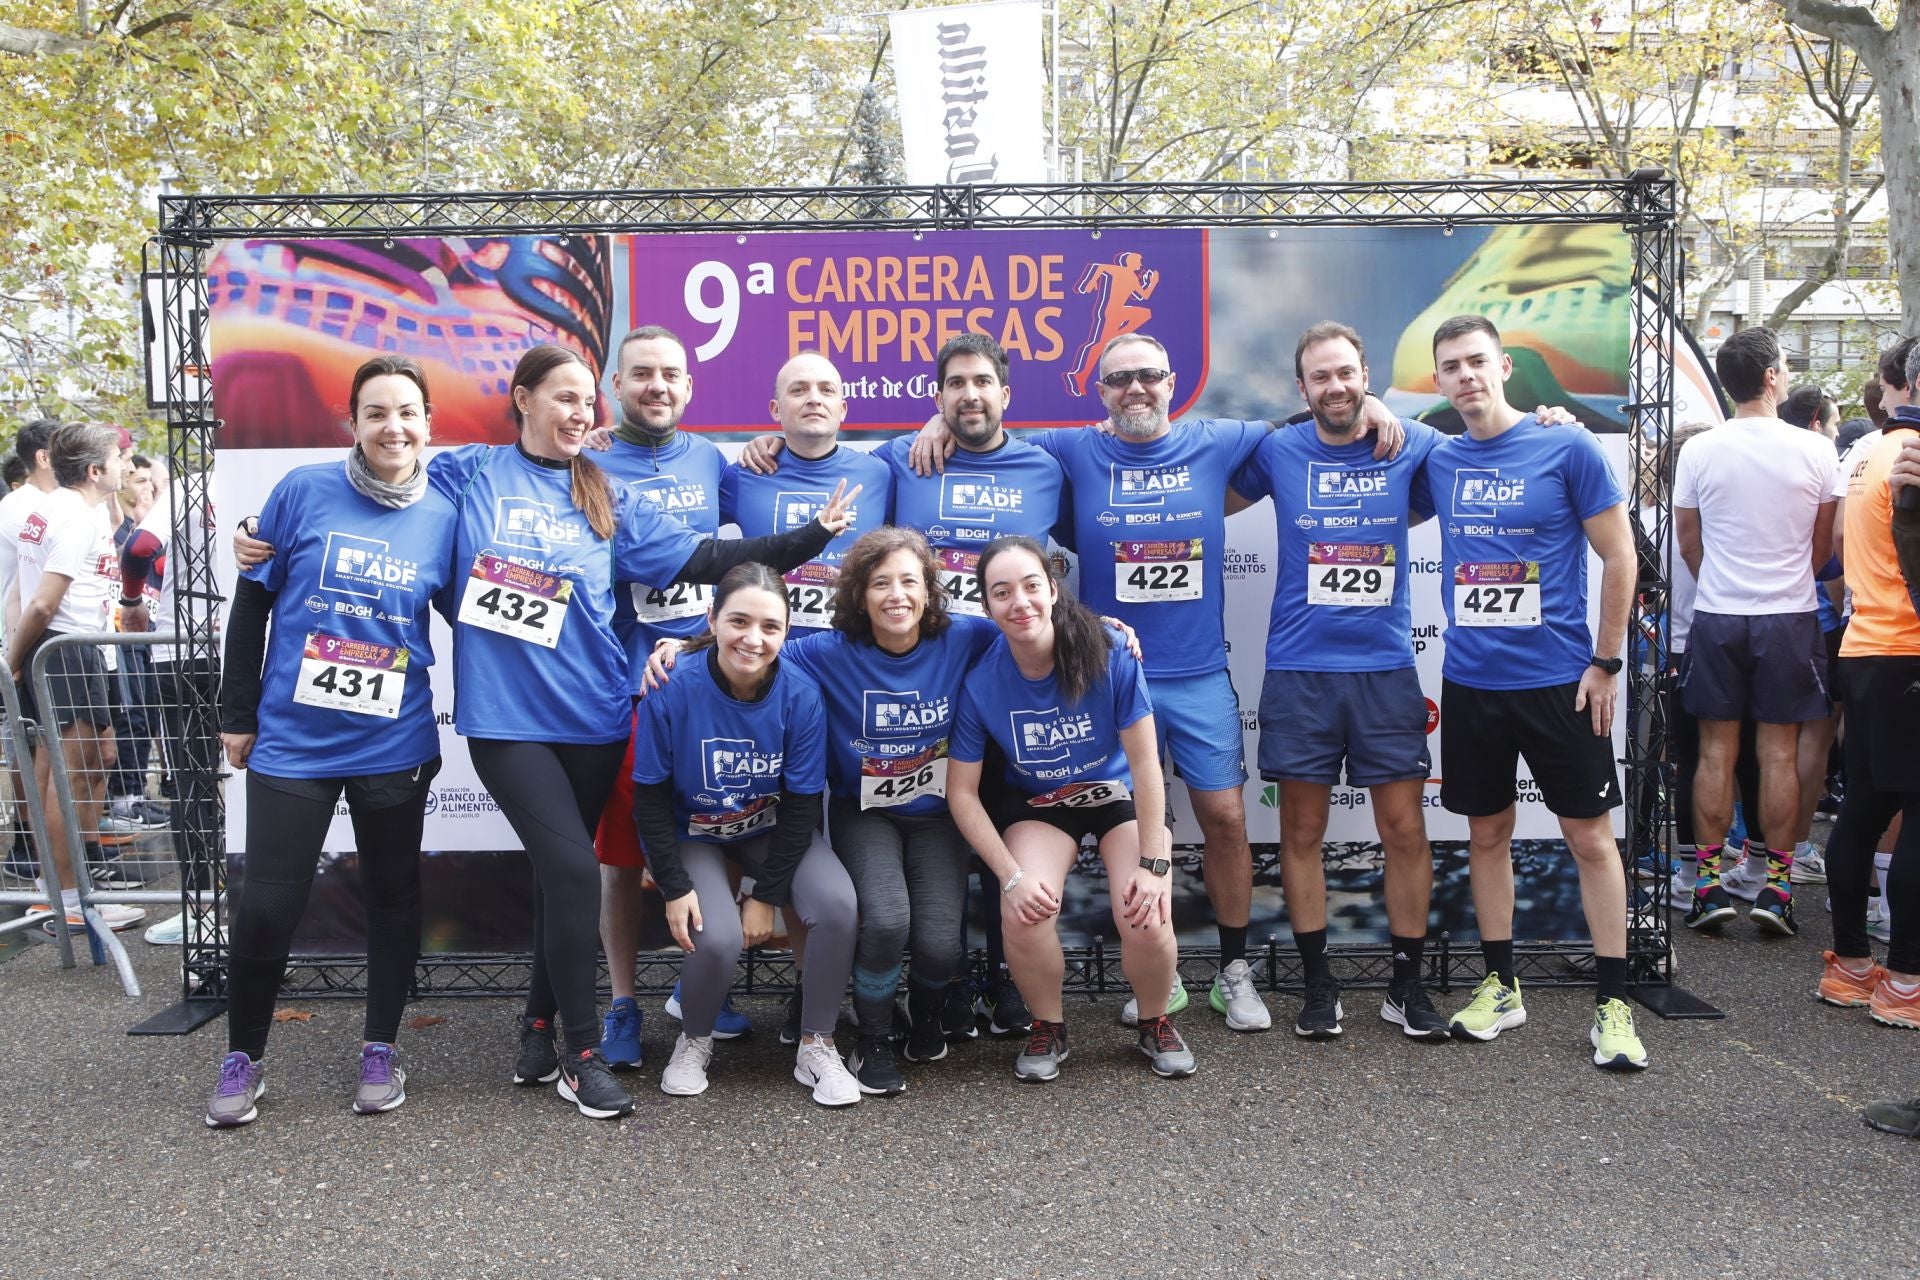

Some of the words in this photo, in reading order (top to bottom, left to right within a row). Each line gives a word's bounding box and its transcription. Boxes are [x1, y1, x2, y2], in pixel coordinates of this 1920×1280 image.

[787, 256, 995, 303] CARRERA
[1008, 255, 1065, 300] DE
[788, 307, 1064, 362] EMPRESAS
[842, 375, 878, 399] orte
[880, 375, 904, 399] de
[1145, 465, 1189, 475] GROUPE
[1146, 472, 1190, 490] ADF
[1343, 477, 1387, 493] ADF
[662, 485, 704, 494] GROUPE
[976, 485, 1022, 494] GROUPE
[1482, 486, 1525, 501] ADF
[667, 490, 706, 509] ADF
[977, 490, 1022, 508] ADF
[1135, 513, 1160, 523] DGH
[1333, 517, 1358, 525] DGH
[533, 519, 581, 541] ADF
[965, 529, 990, 538] DGH
[1471, 525, 1494, 534] DGH
[1144, 548, 1176, 556] EMPRESAS
[1245, 554, 1258, 563] DE
[367, 552, 419, 569] GROUPE
[518, 558, 545, 571] DGH
[364, 560, 417, 585] ADF
[505, 570, 542, 587] EMPRESAS
[507, 564, 535, 578] CARRERA
[535, 572, 544, 580] DE
[1128, 564, 1189, 590] 422
[1320, 567, 1382, 593] 429
[646, 581, 703, 608] 421
[944, 574, 983, 602] 42
[1464, 587, 1525, 613] 427
[345, 603, 373, 617] DGH
[476, 587, 549, 630] 432
[339, 647, 377, 660] EMPRESAS
[341, 641, 370, 652] CARRERA
[312, 665, 384, 701] 431
[901, 696, 948, 710] GROUPE
[903, 703, 949, 726] ADF
[1045, 712, 1090, 729] GROUPE
[1049, 719, 1092, 745] ADF
[736, 751, 784, 759] GROUPE
[890, 744, 915, 754] DGH
[734, 758, 783, 774] ADF
[1045, 766, 1071, 777] DGH
[874, 765, 934, 798] 426
[440, 793, 476, 802] BANCO
[479, 793, 492, 801] DE
[441, 803, 500, 812] ALIMENTOS
[703, 812, 764, 835] 430
